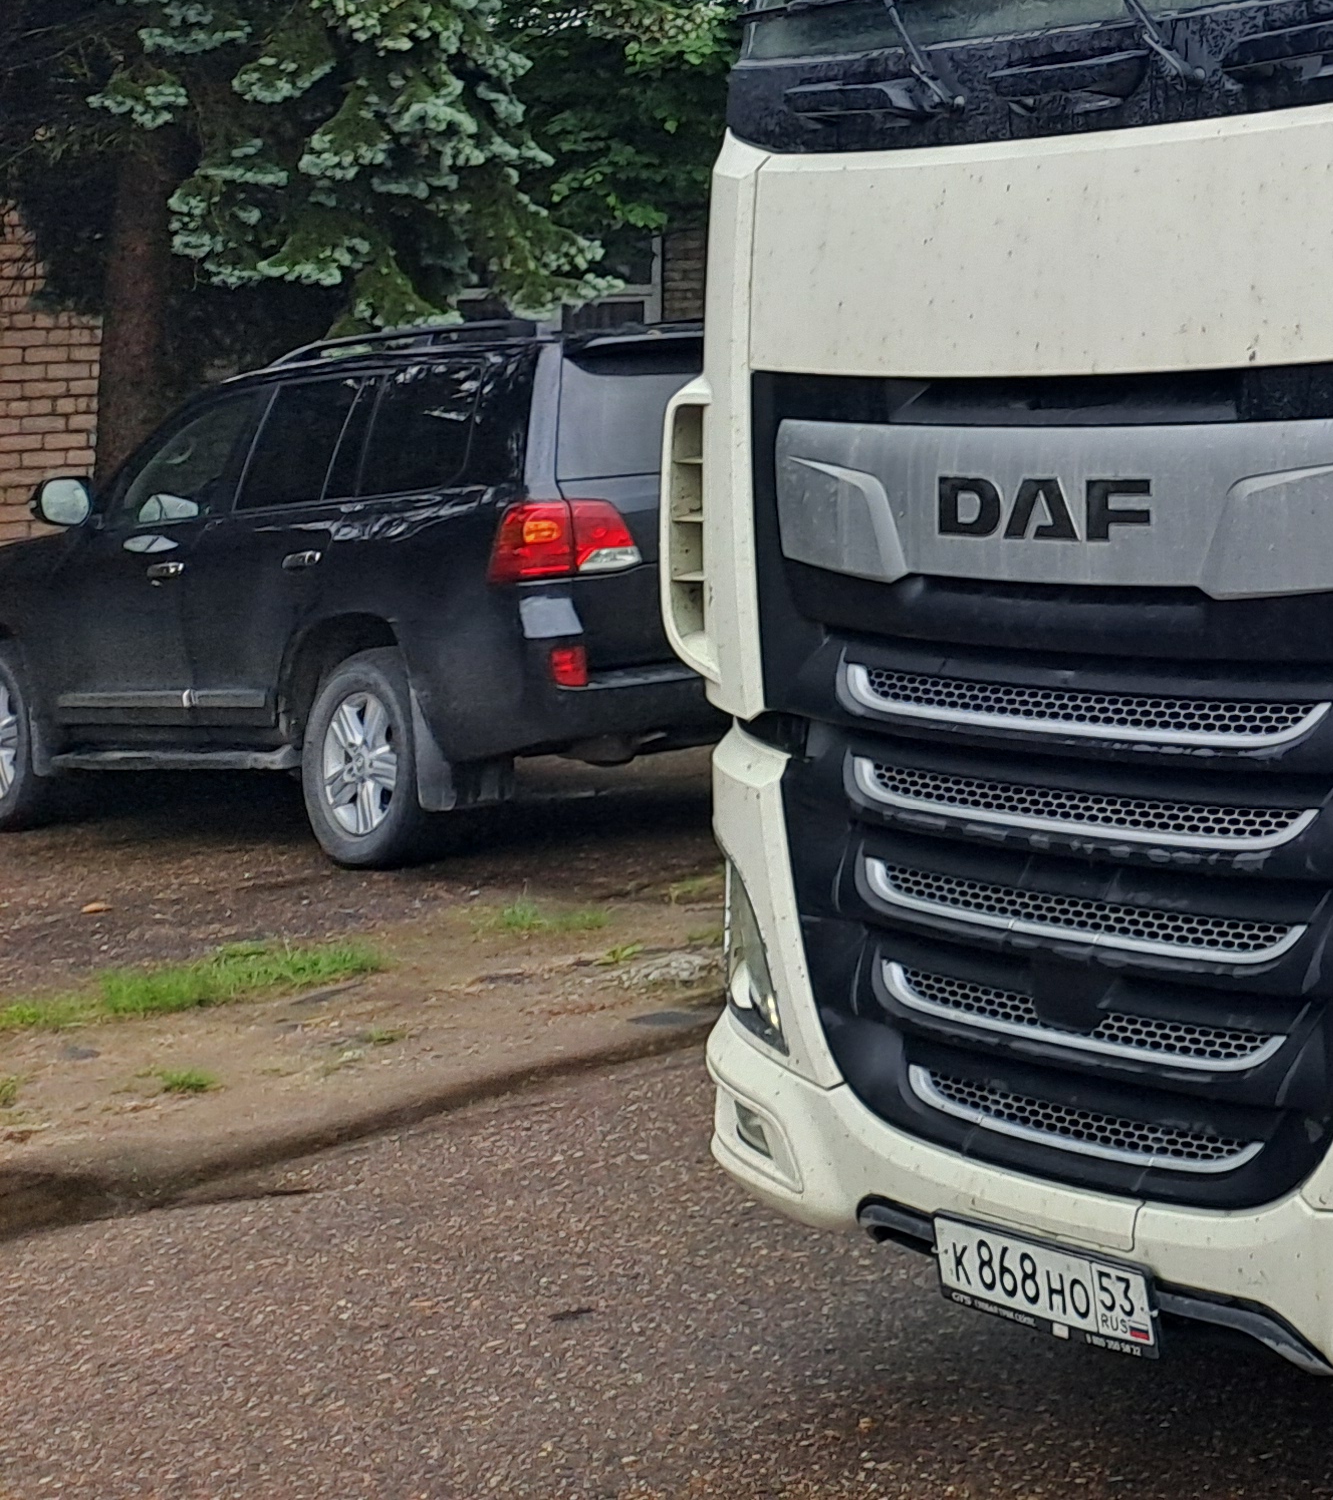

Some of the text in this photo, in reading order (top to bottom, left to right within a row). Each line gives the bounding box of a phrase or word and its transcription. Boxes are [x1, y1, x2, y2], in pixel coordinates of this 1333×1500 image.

[937, 476, 1152, 543] DAF
[1097, 1269, 1135, 1318] 53
[1101, 1312, 1129, 1335] RUS
